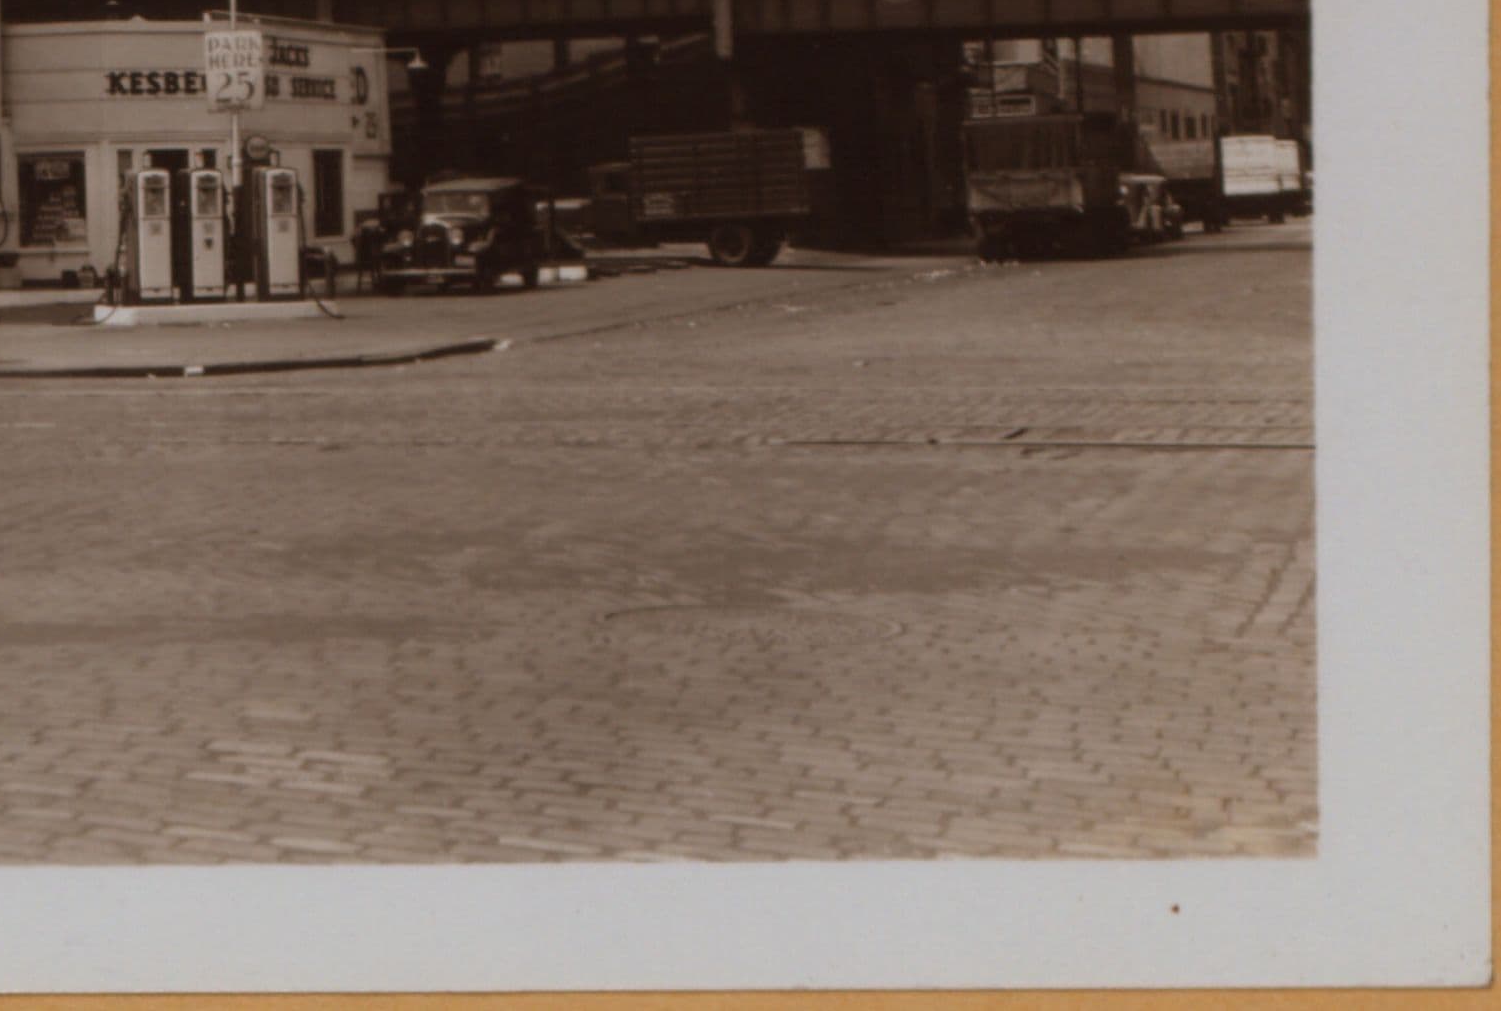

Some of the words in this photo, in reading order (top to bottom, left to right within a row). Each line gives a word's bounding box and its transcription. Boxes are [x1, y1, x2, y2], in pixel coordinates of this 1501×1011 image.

[208, 36, 261, 53] PARK
[209, 53, 258, 69] HERE
[215, 72, 256, 103] 25
